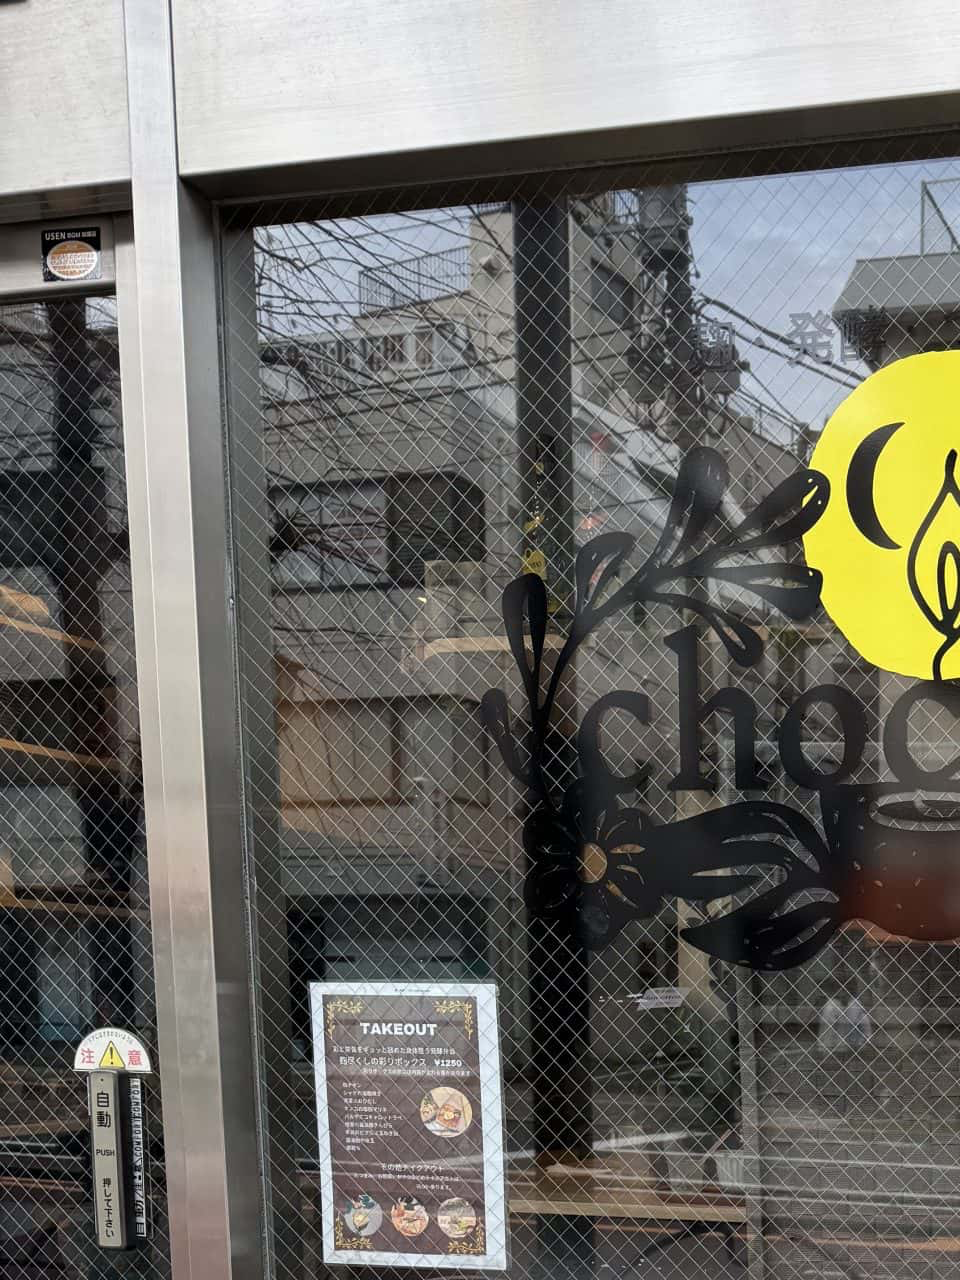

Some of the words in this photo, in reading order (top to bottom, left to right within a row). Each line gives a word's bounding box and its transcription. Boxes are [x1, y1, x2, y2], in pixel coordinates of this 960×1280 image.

[45, 231, 66, 241] USEN
[360, 1022, 438, 1037] TAKEOUT
[96, 1090, 112, 1129] 自動
[96, 1148, 115, 1157] PUSH
